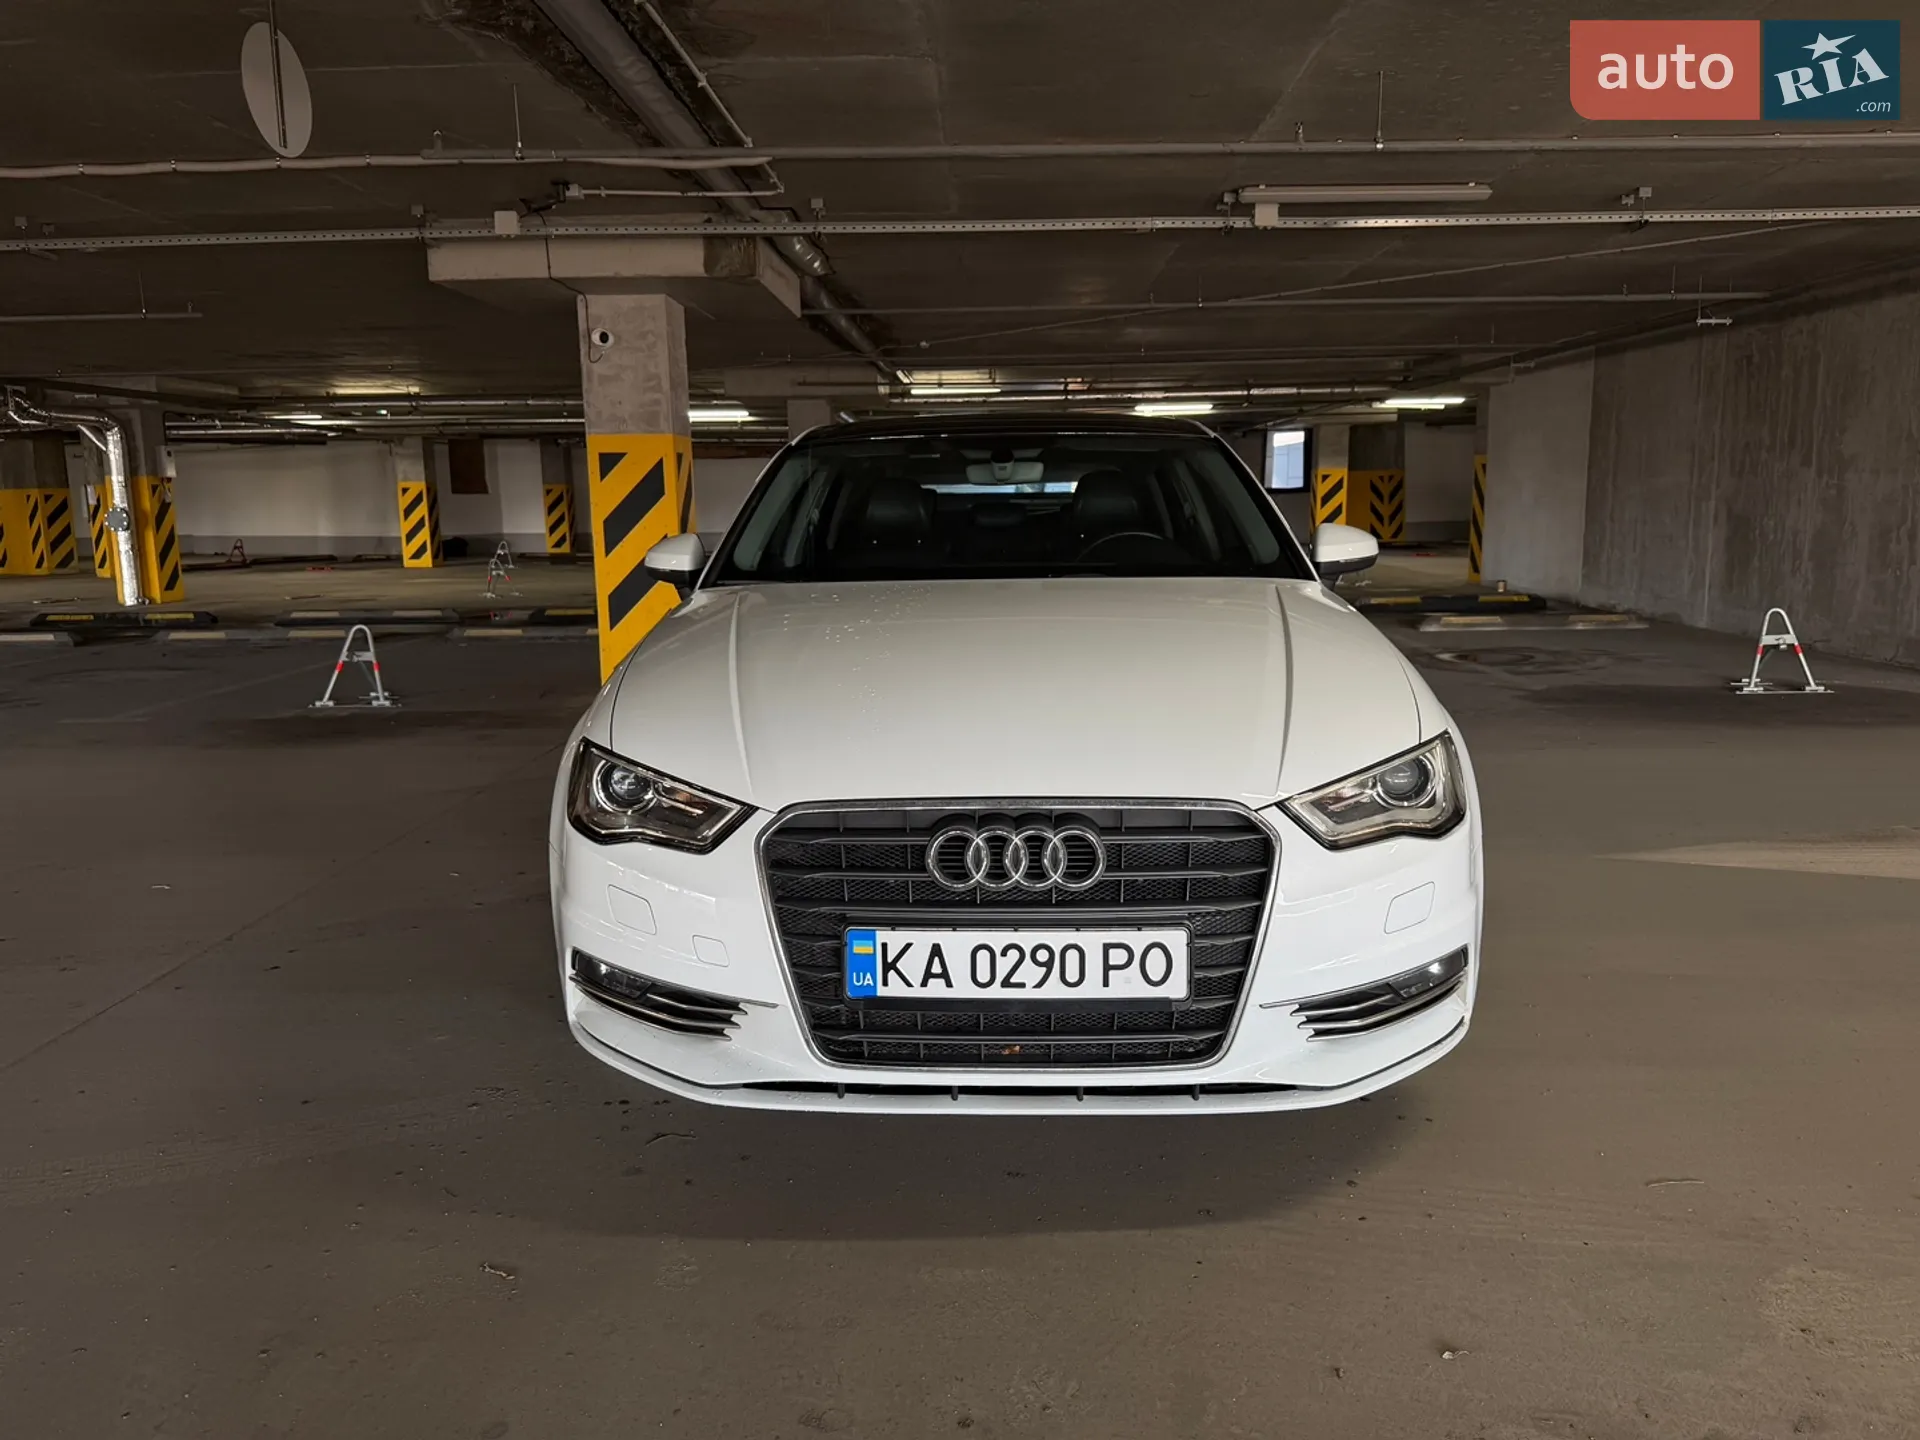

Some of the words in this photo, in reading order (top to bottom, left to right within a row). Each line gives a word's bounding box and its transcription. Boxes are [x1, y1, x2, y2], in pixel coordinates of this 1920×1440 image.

[852, 972, 875, 988] UA
[880, 941, 954, 988] KA
[970, 942, 1086, 989] 0290
[1101, 941, 1173, 988] PO
